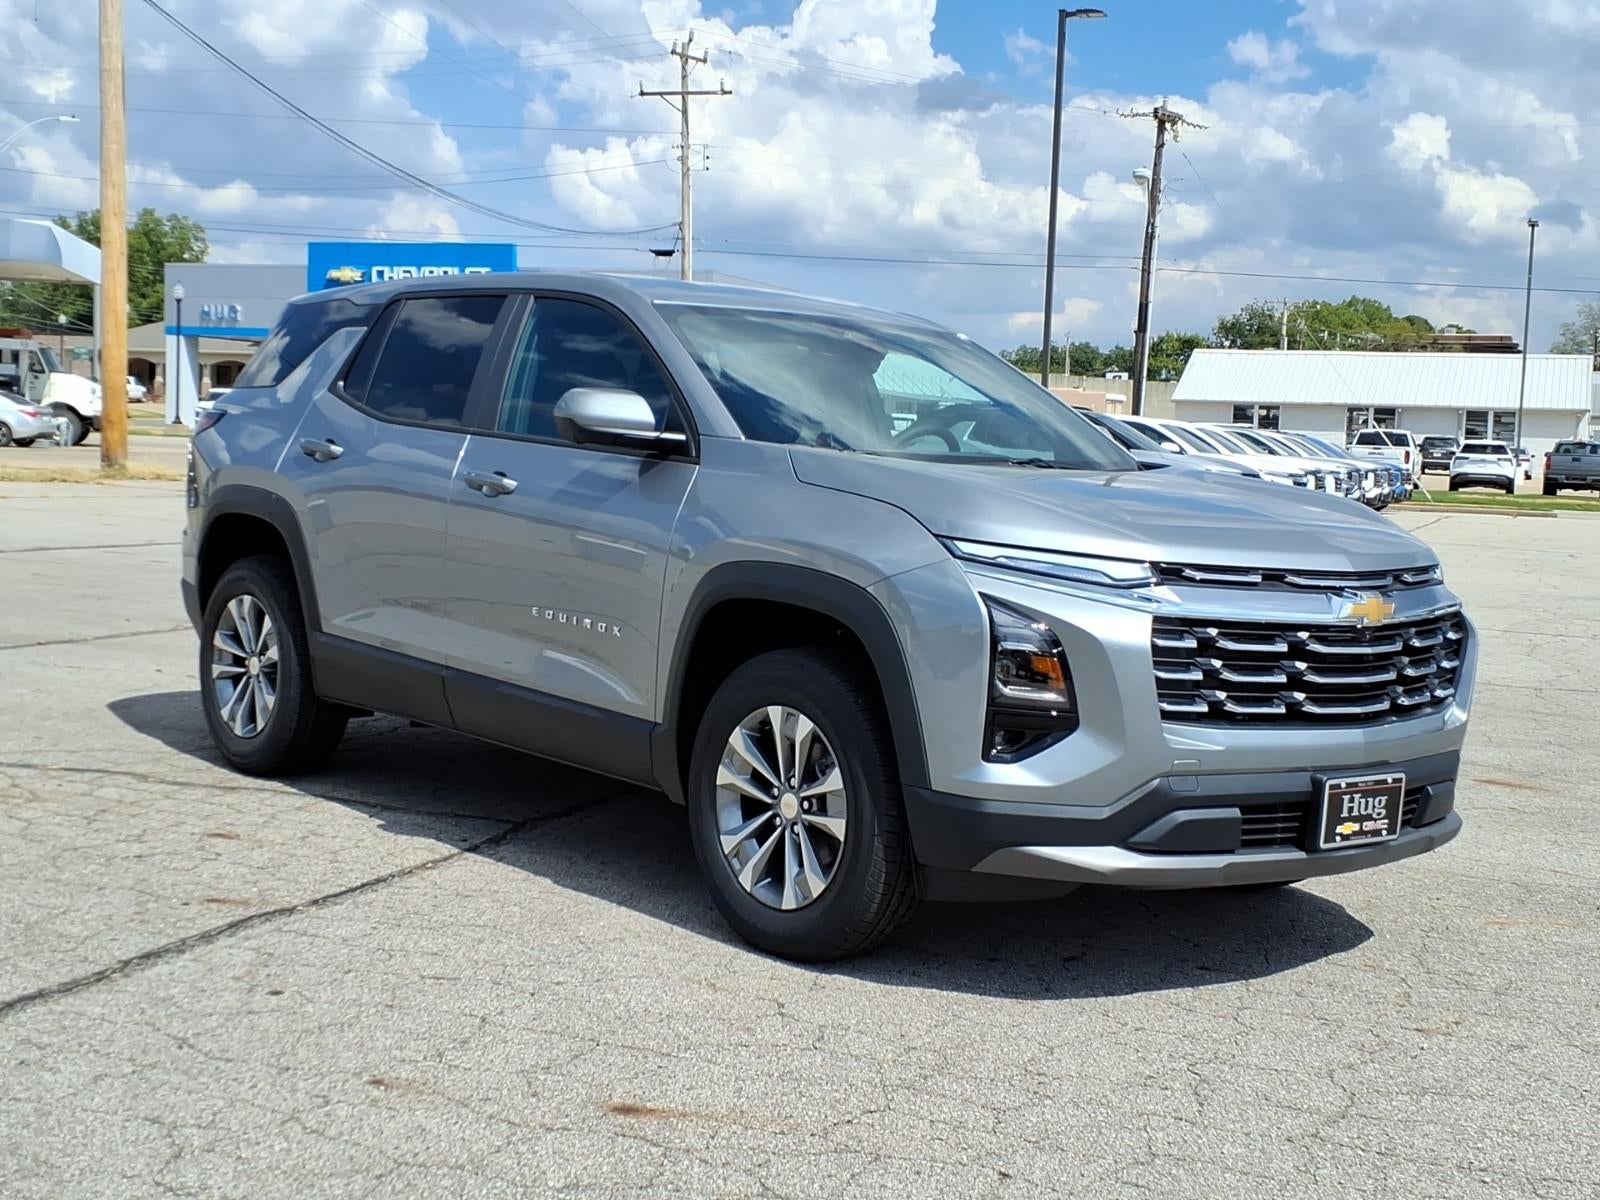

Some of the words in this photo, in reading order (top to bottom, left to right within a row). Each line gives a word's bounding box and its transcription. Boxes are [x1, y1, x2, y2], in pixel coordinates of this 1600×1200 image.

[371, 266, 492, 282] CHEVRO
[200, 304, 241, 321] HUG
[532, 606, 621, 637] EQUINOX
[1340, 793, 1388, 819] Hug
